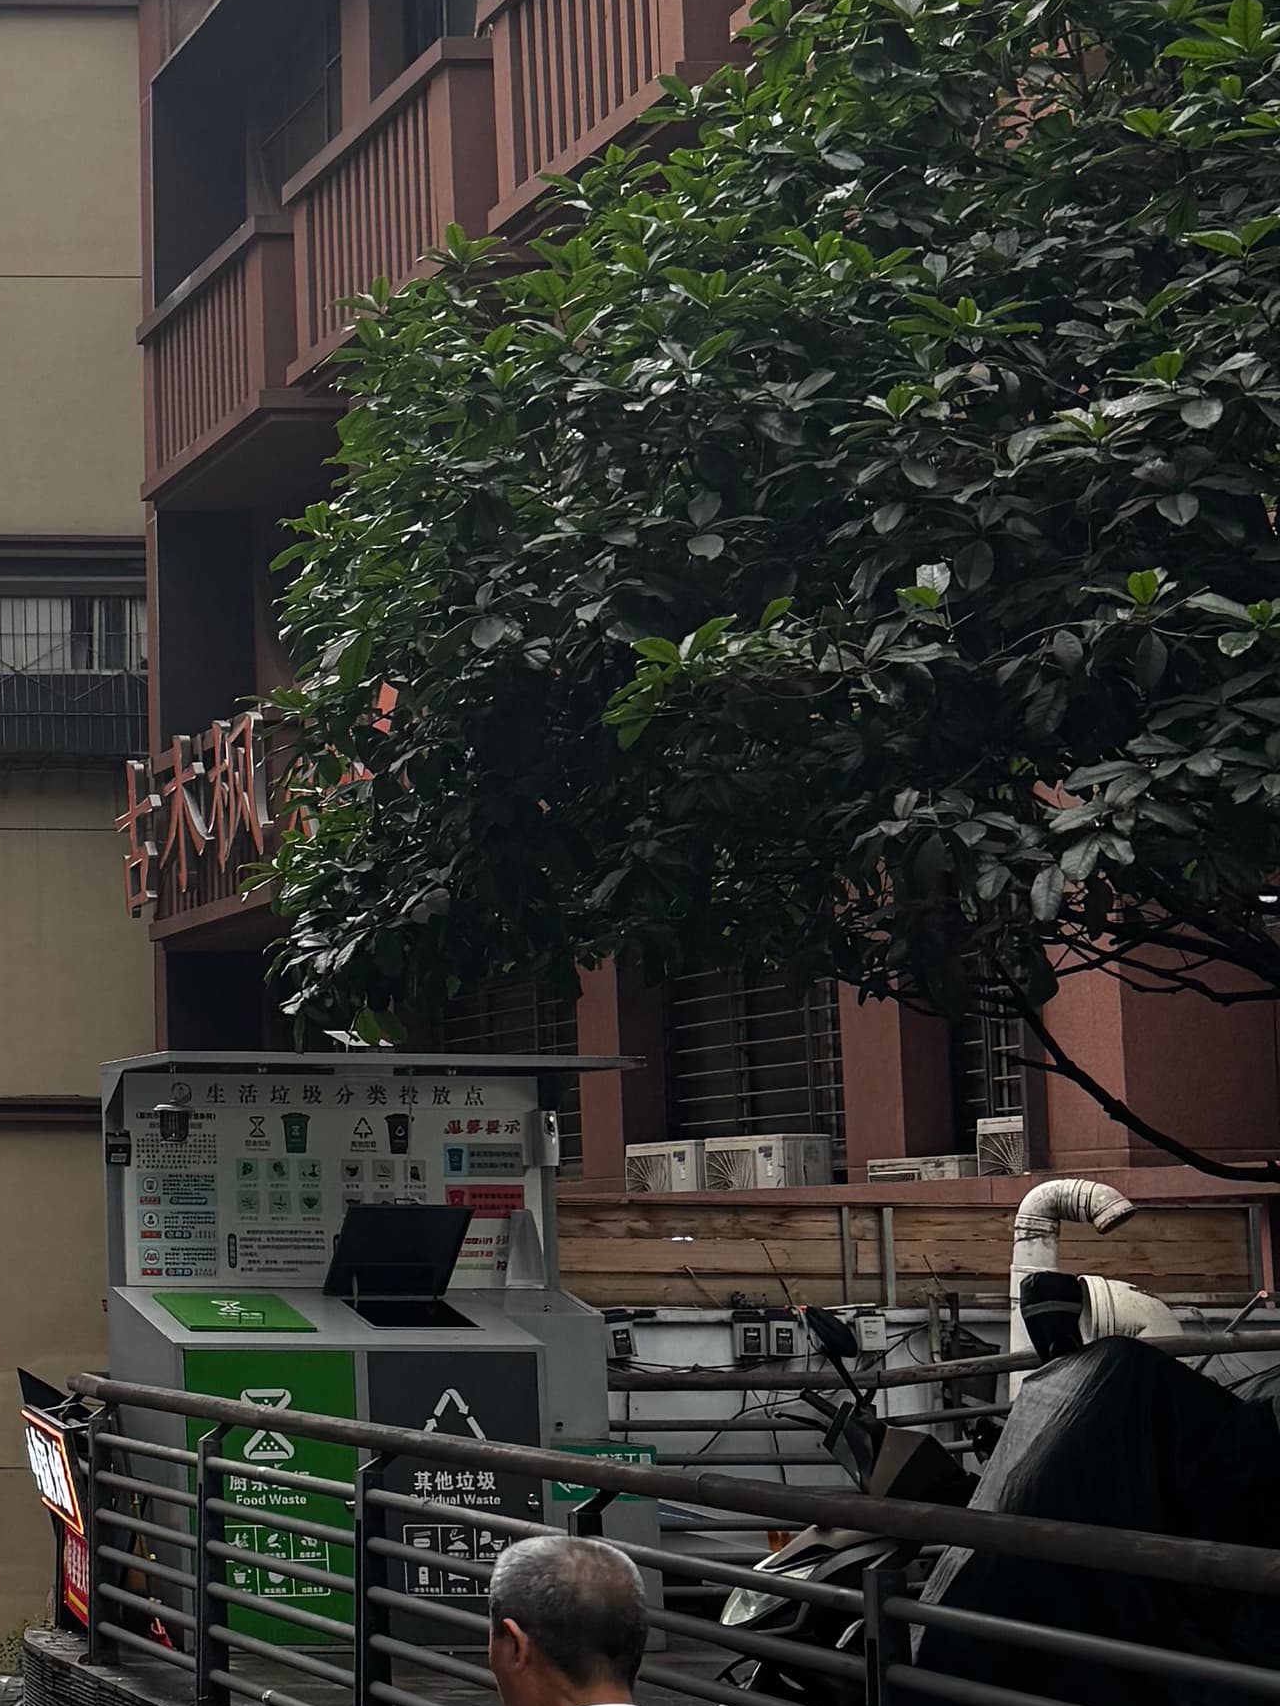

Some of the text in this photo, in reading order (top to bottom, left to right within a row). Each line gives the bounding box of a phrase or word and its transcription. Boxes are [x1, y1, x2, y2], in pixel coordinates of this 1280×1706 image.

[206, 1083, 485, 1106] 生活垃圾分类投放点
[443, 1119, 521, 1135] 温馨提示
[414, 1470, 497, 1491] 其他垃圾
[236, 1494, 307, 1506] Food Waste
[464, 1493, 501, 1506] Waste
